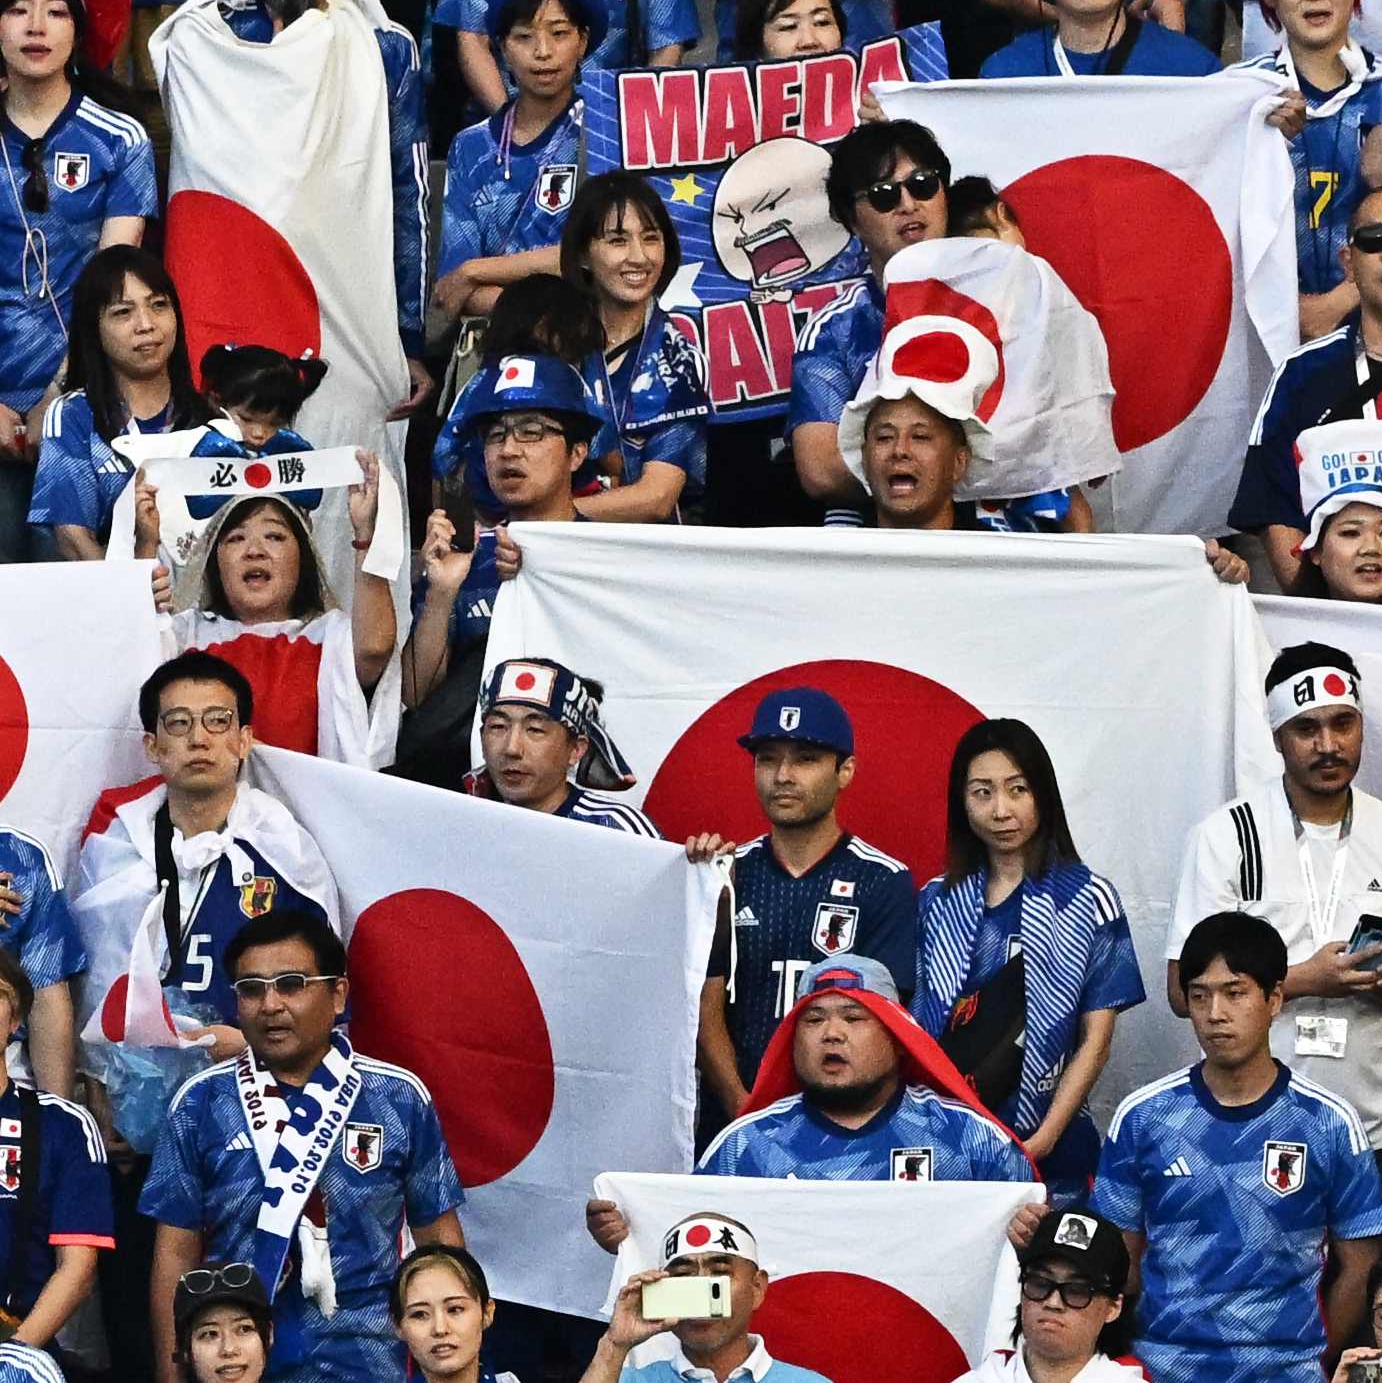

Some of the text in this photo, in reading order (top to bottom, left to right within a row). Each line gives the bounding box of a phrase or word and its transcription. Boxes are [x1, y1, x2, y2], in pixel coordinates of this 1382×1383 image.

[615, 37, 908, 172] MAEDA
[209, 458, 307, 490] 必勝
[1320, 453, 1347, 471] GO!
[182, 933, 214, 992] 5
[663, 1226, 740, 1263] 日本
